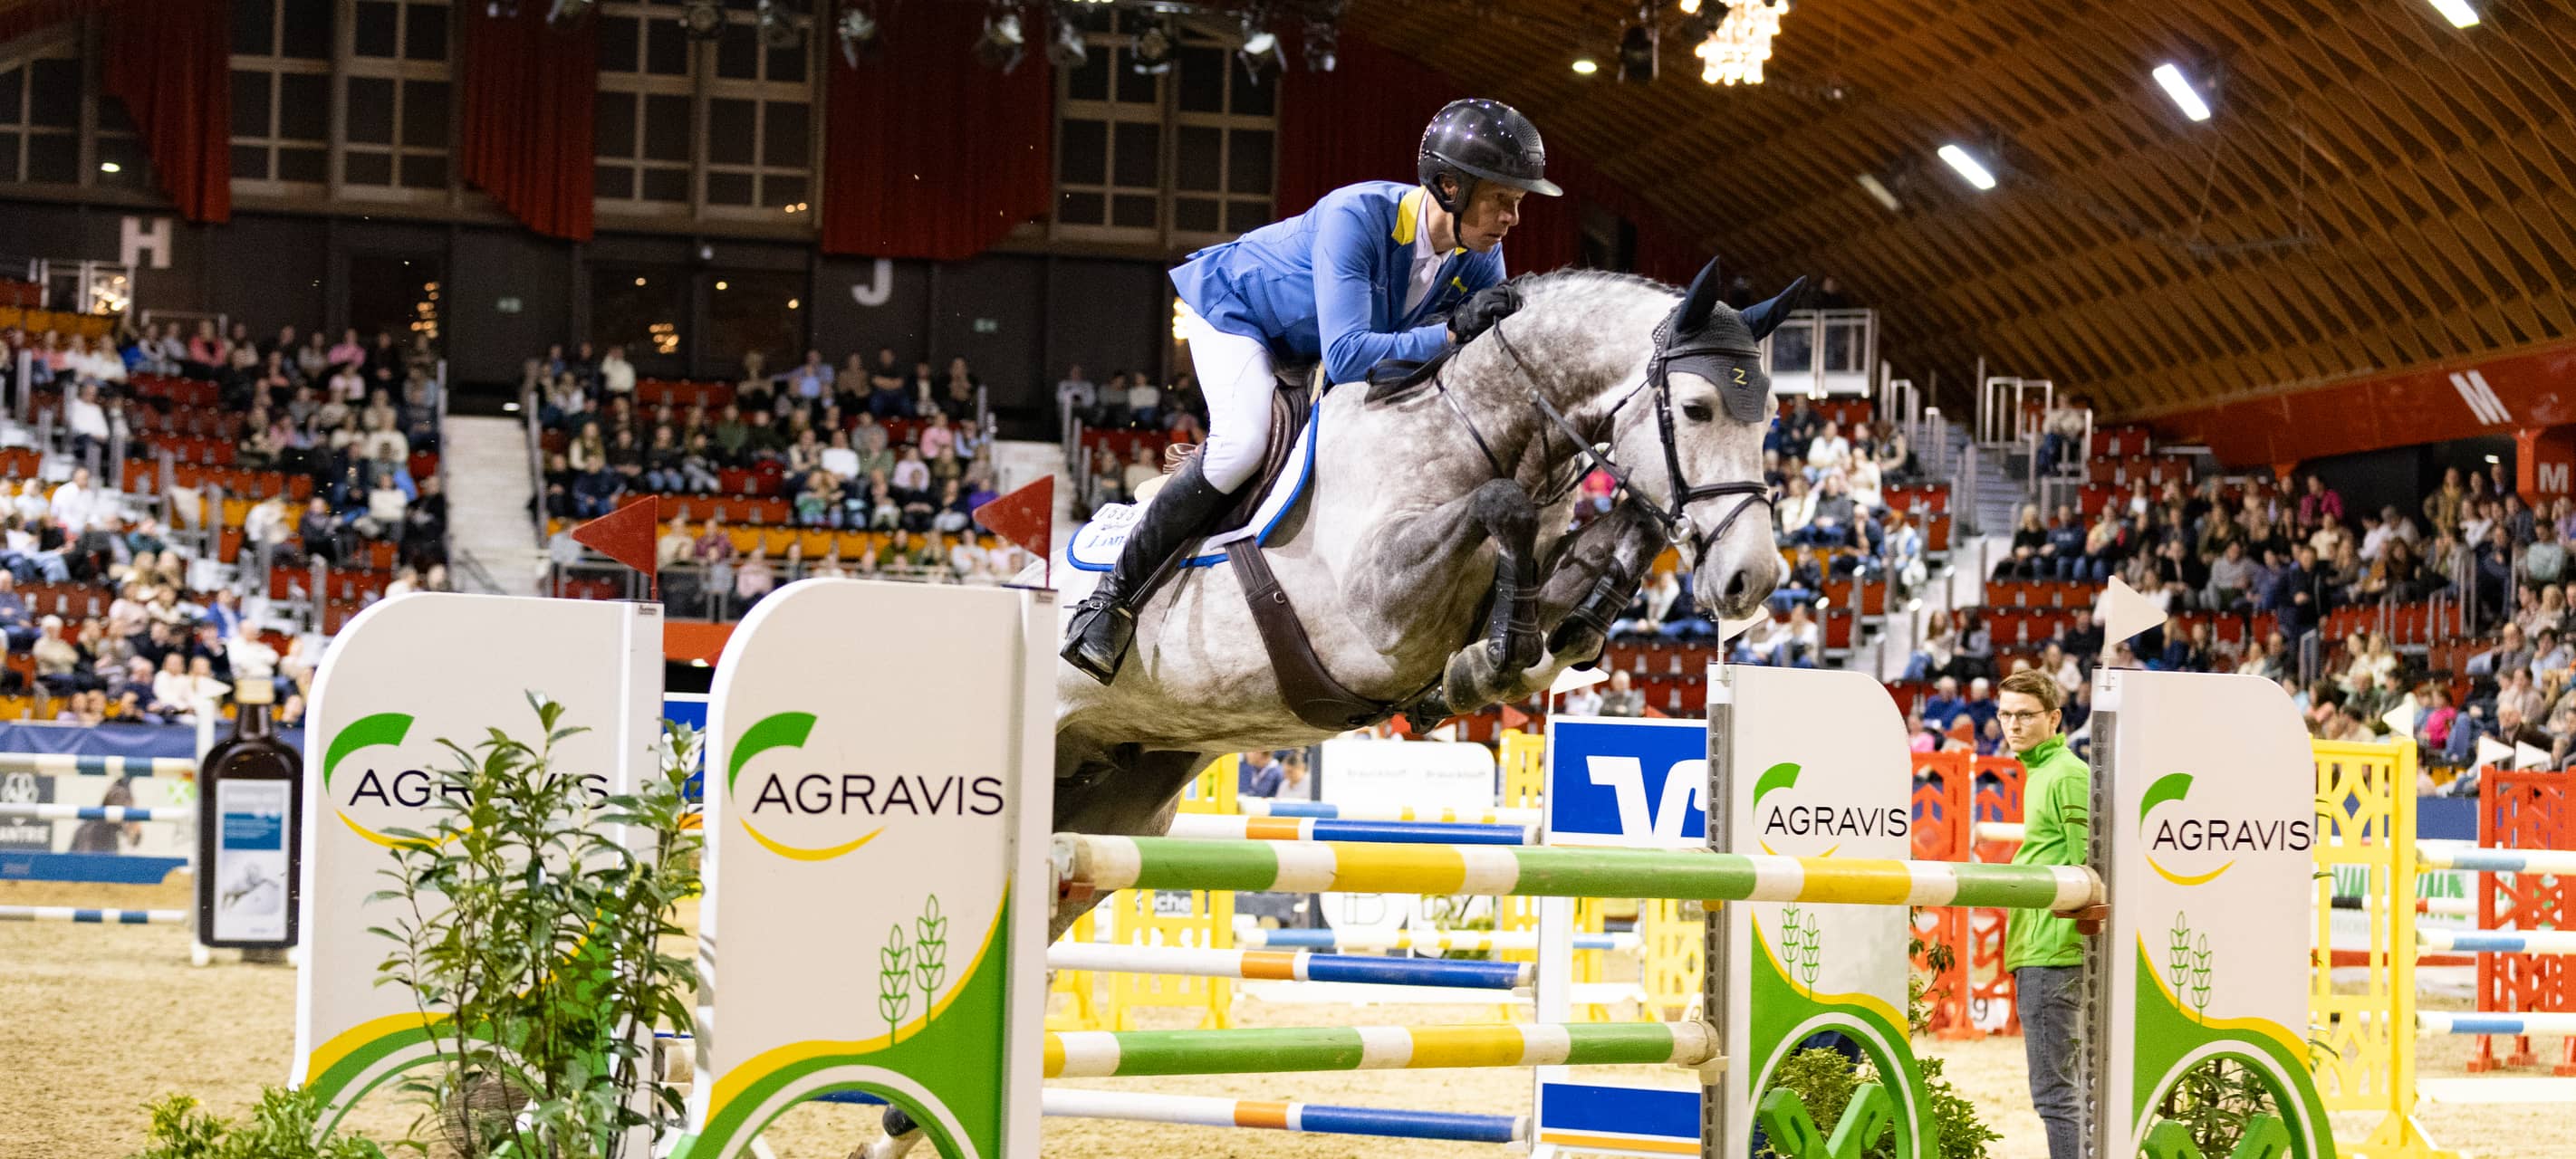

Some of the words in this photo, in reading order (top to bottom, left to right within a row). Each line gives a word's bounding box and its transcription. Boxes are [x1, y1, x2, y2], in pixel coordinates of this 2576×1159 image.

[120, 216, 171, 267] H
[852, 259, 893, 305] J
[2449, 369, 2512, 426] M
[2539, 463, 2570, 493] M
[751, 772, 1004, 816] AGRAVIS
[1764, 805, 1908, 838] AGRAVIS
[2152, 819, 2311, 851] AGRAVIS
[1973, 997, 1988, 1022] 9
